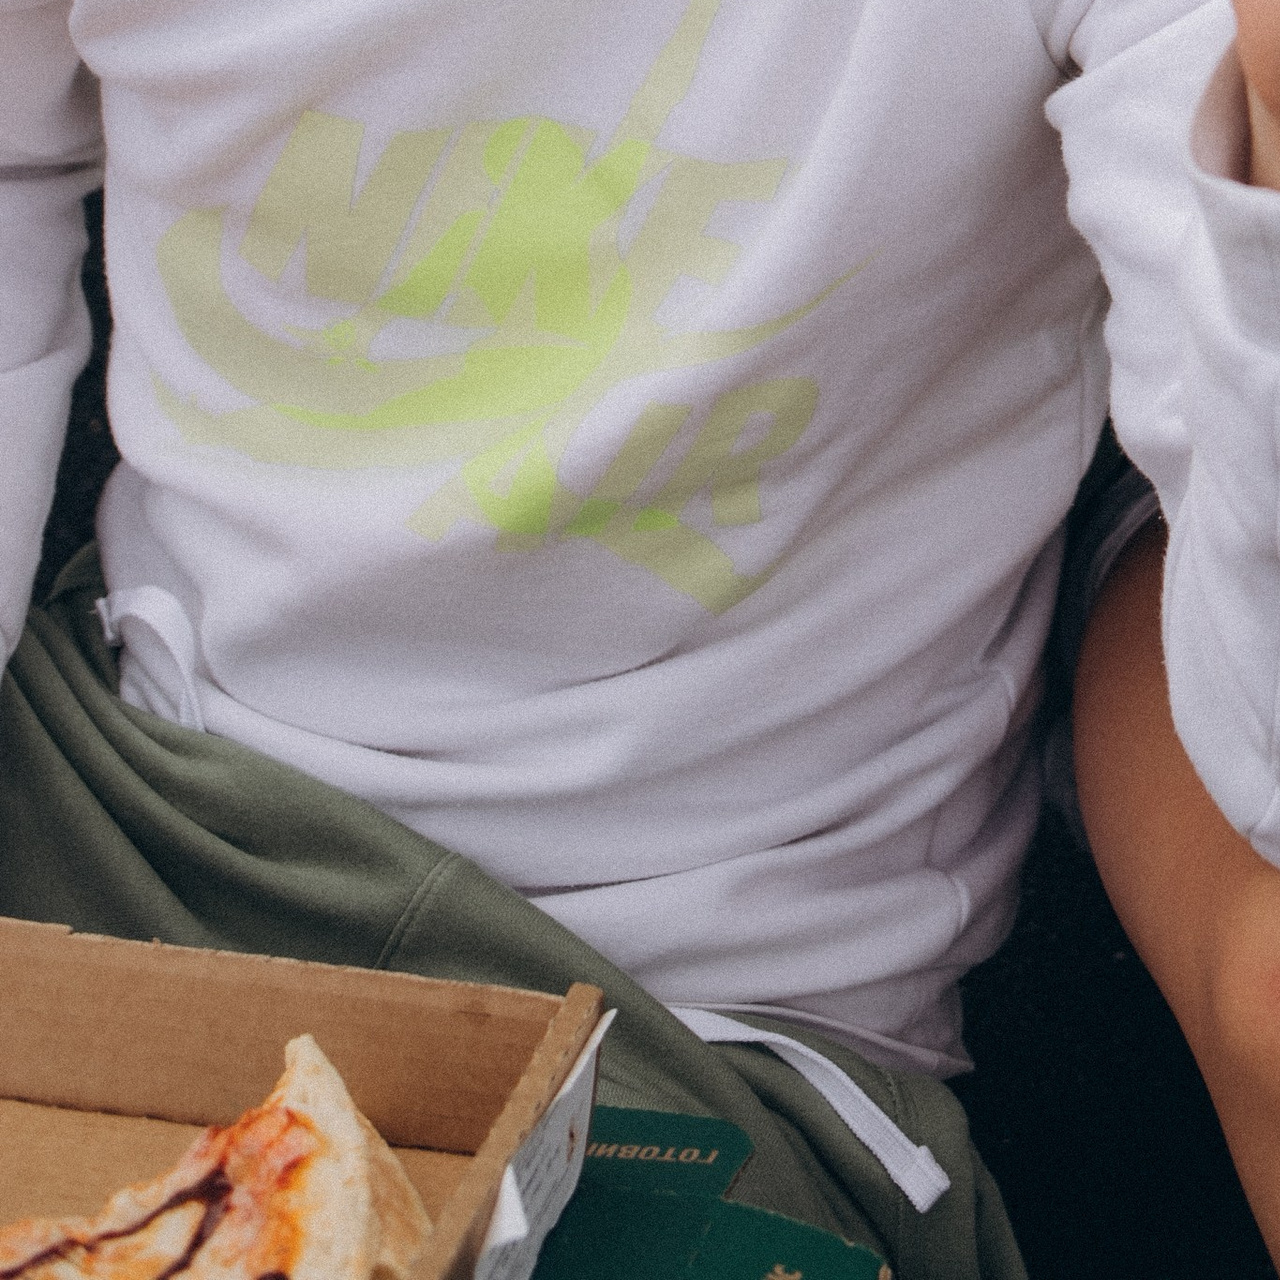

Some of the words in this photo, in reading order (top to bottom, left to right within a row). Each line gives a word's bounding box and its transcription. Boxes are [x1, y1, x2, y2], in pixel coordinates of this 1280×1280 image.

[239, 109, 788, 340] NIKE
[403, 376, 820, 554] AIR
[585, 1143, 719, 1165] ГОТОВИ
